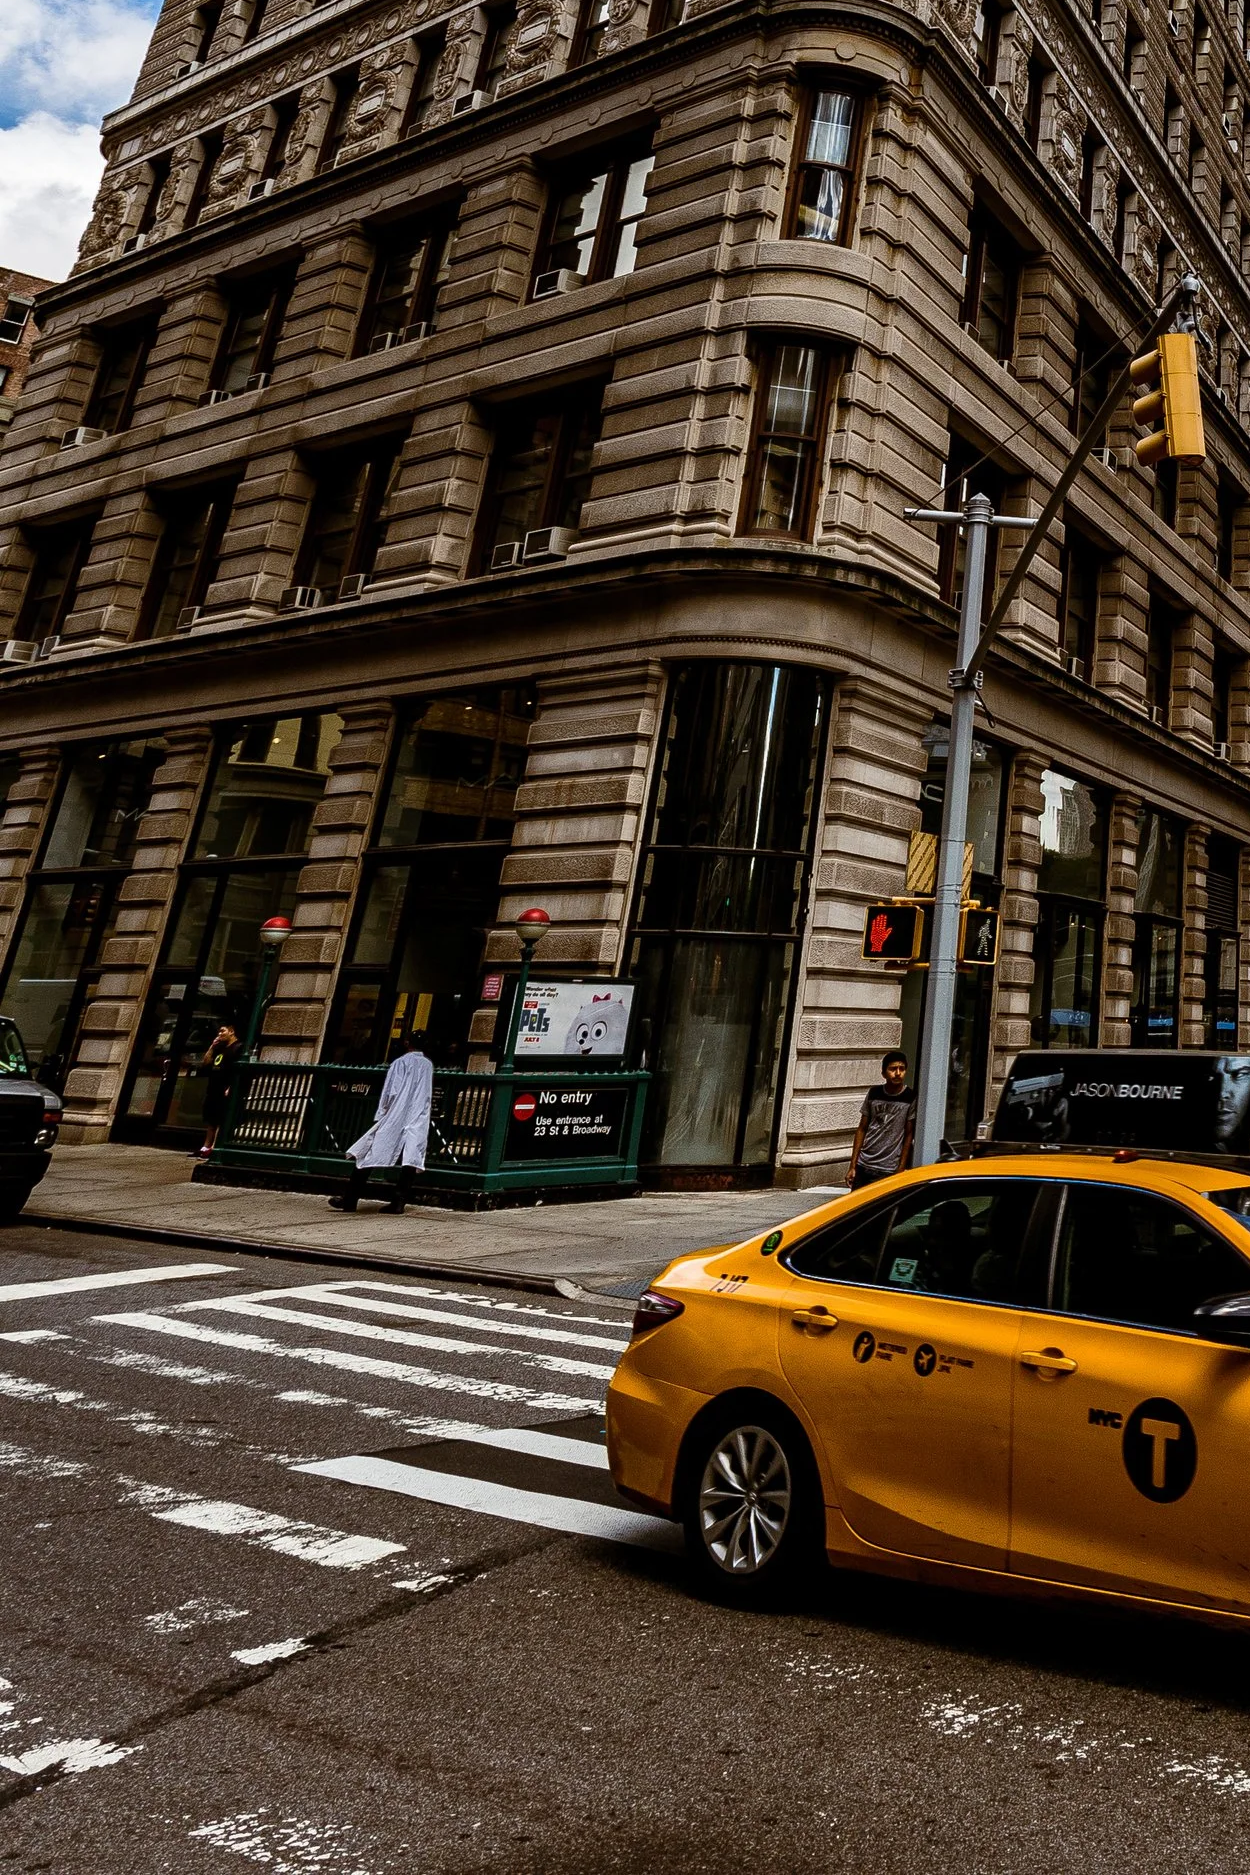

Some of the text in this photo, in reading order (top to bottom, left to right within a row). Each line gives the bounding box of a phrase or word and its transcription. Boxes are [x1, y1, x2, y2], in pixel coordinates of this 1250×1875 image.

[337, 1081, 371, 1095] No entry
[539, 1091, 593, 1105] No entry
[536, 1114, 603, 1125] Use entrance at
[534, 1125, 612, 1136] 23 St & Broadway
[1088, 1408, 1122, 1429] NYC
[1141, 1417, 1181, 1489] T
